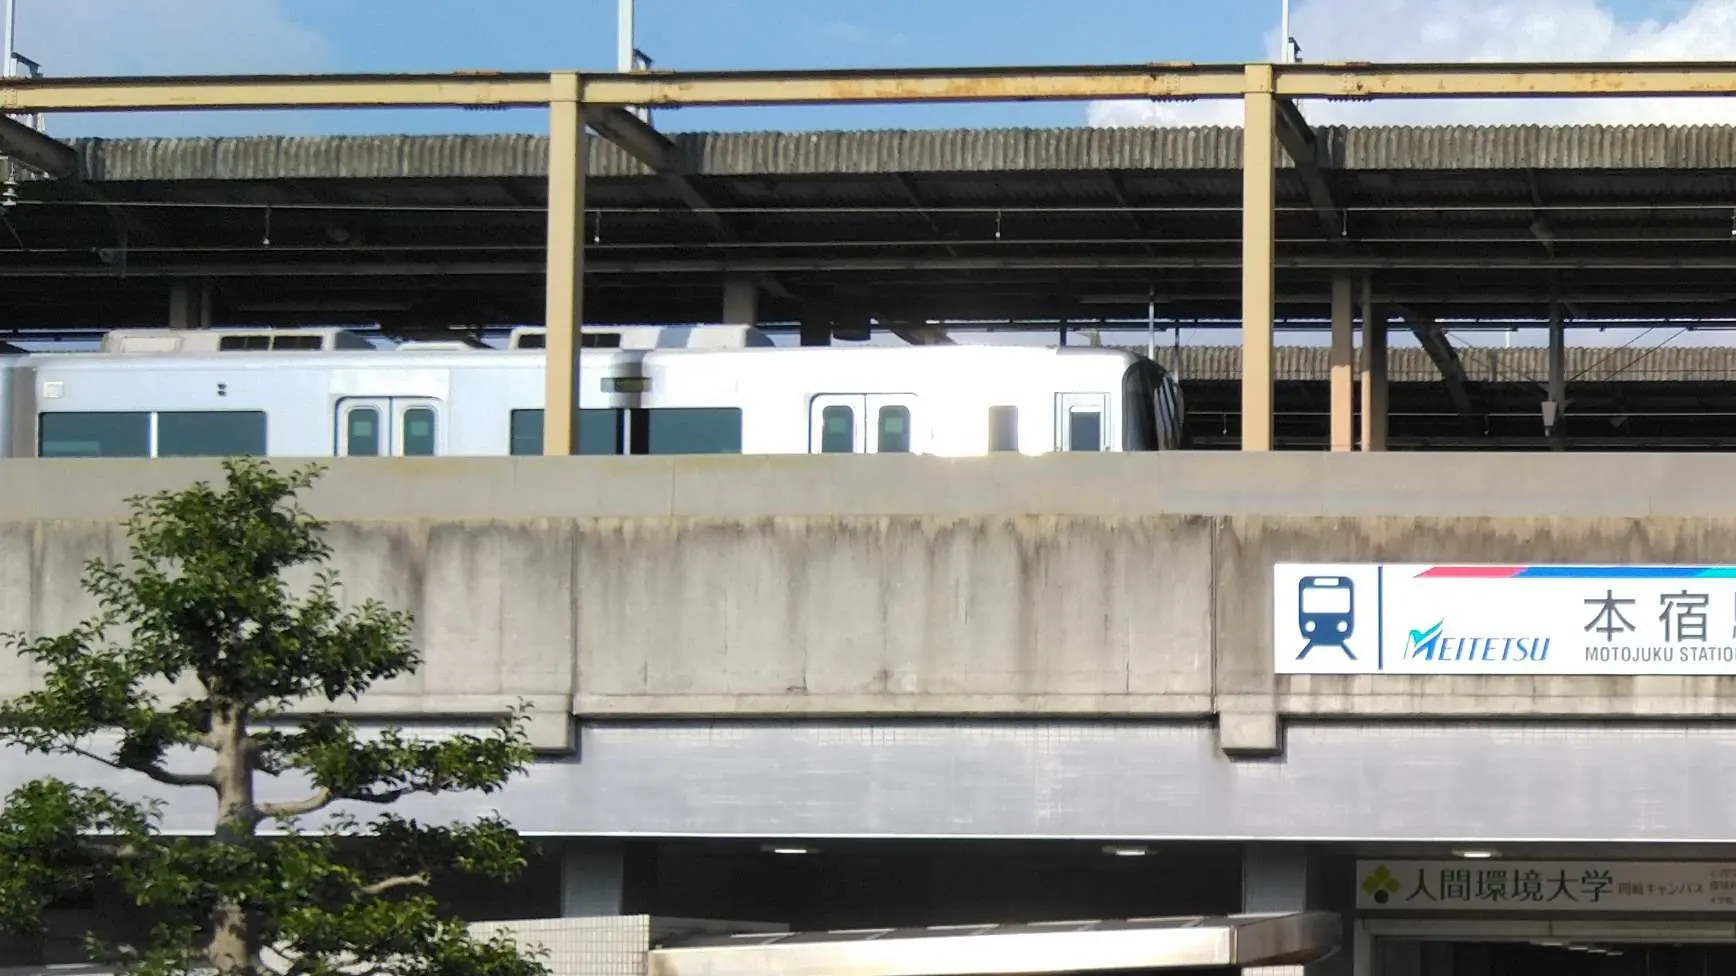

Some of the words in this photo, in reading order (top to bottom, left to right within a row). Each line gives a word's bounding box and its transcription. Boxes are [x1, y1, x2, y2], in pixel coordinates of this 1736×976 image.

[1404, 617, 1551, 662] MEITETSU
[1585, 646, 1674, 662] MOTOJUKU
[1405, 868, 1613, 903] 人間環境大学
